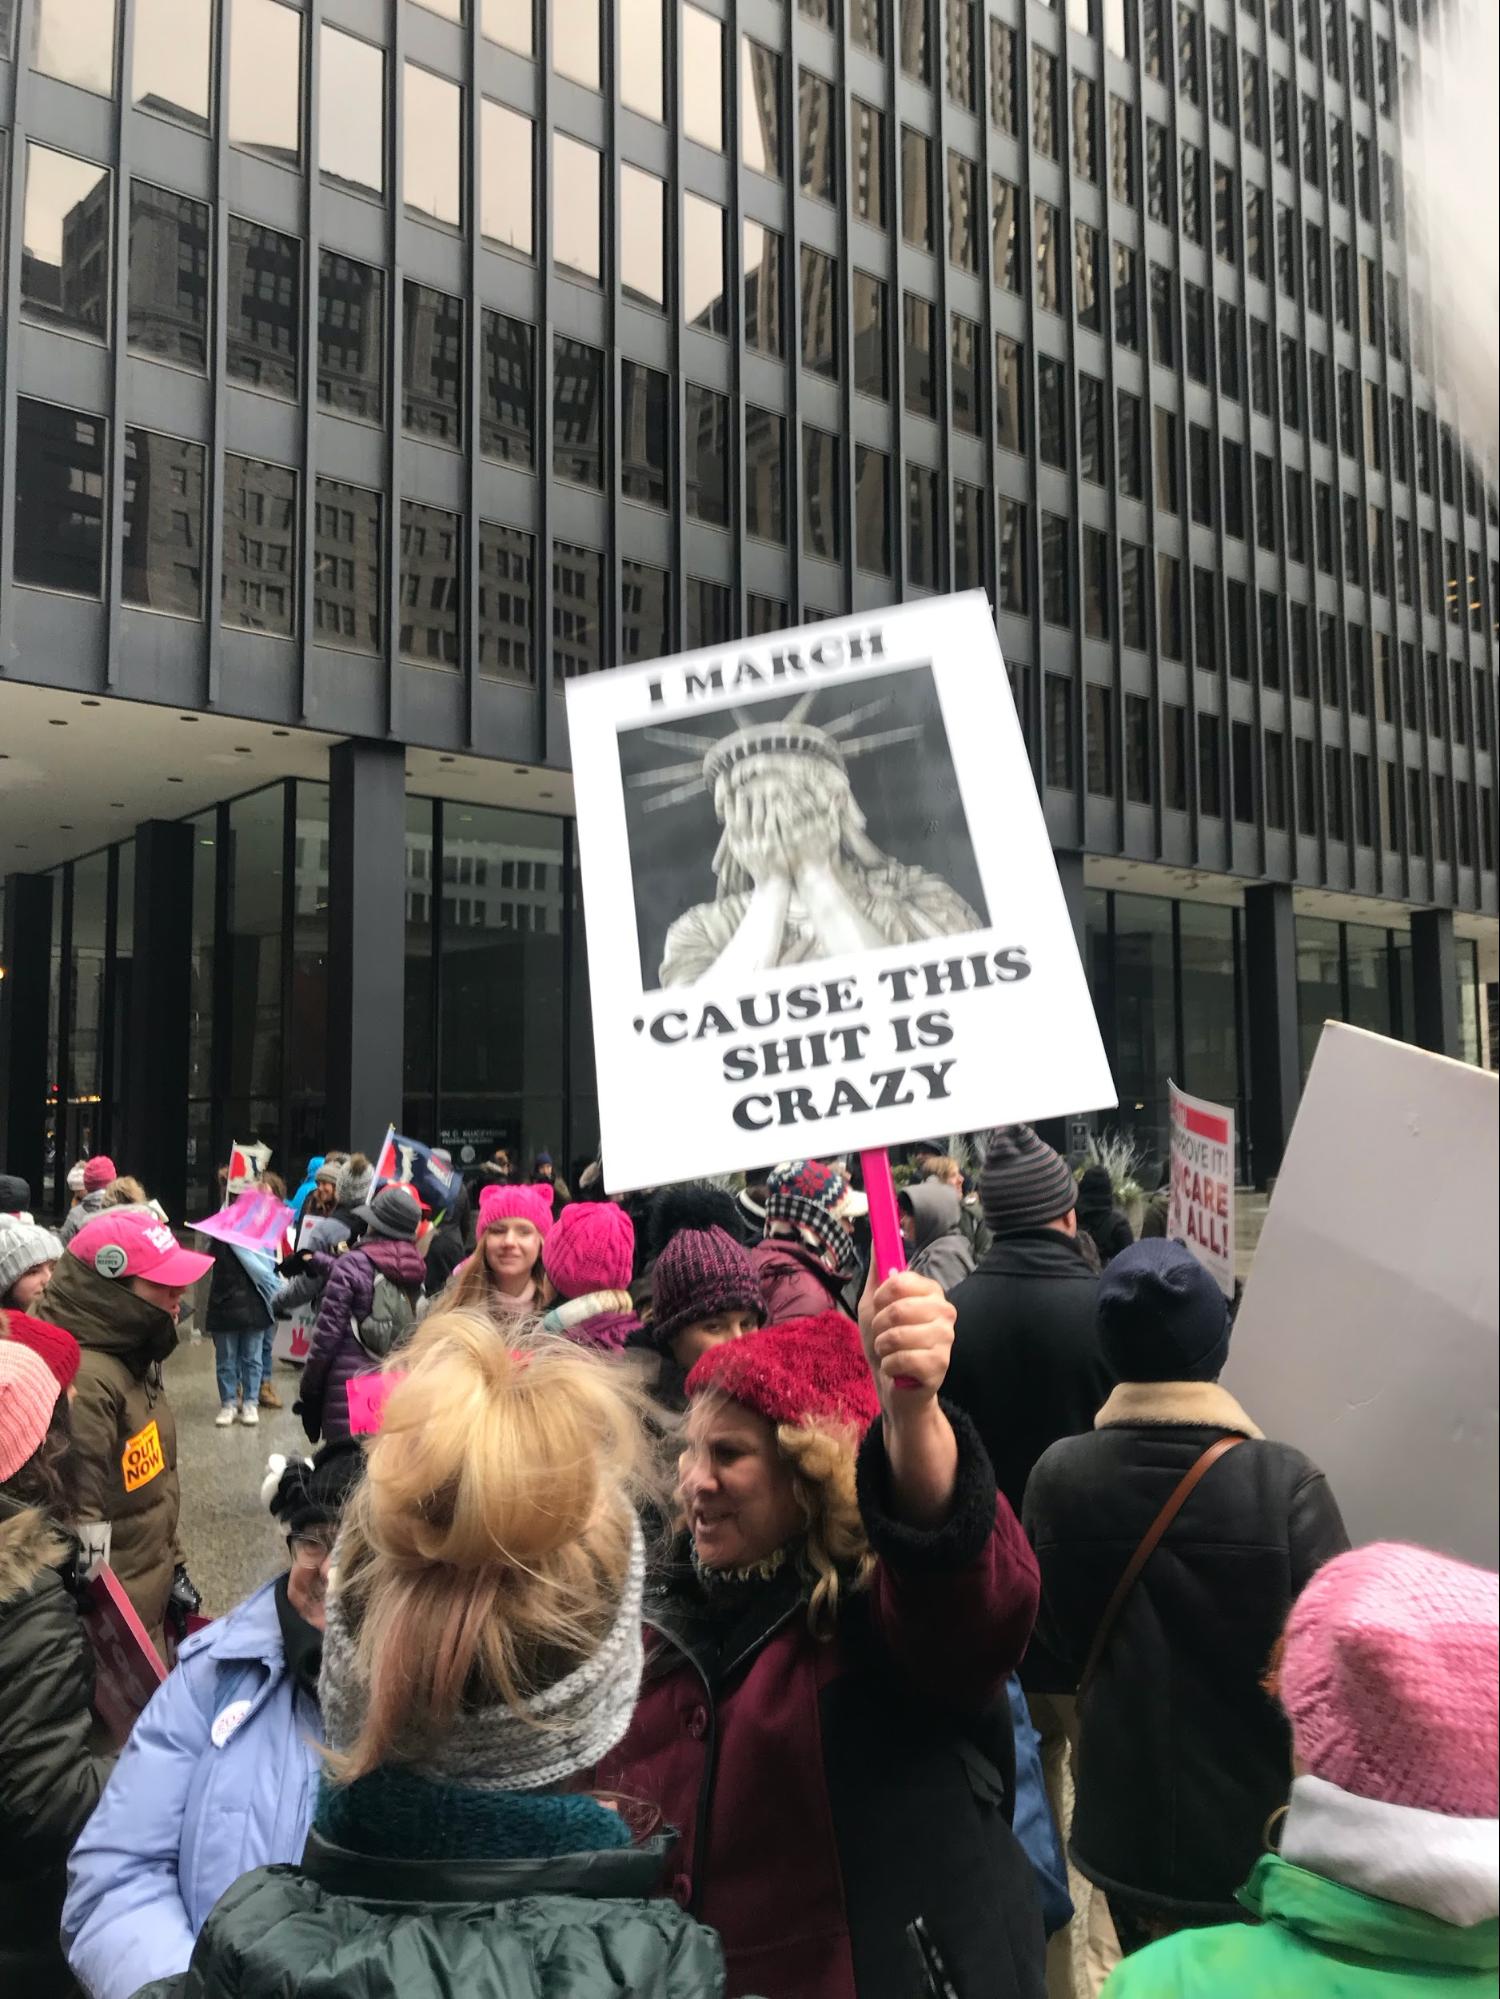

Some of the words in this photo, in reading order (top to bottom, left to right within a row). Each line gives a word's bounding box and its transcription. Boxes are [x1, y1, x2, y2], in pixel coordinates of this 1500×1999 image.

[648, 675, 665, 703] I
[685, 625, 884, 695] MARCH
[878, 945, 1032, 1003] THIS
[722, 1023, 871, 1082] SHIT
[890, 1009, 955, 1053] IS
[732, 1058, 957, 1131] CRAZY
[1187, 1203, 1229, 1259] ALL!
[126, 1449, 160, 1484] NOW
[128, 1435, 154, 1466] OUT
